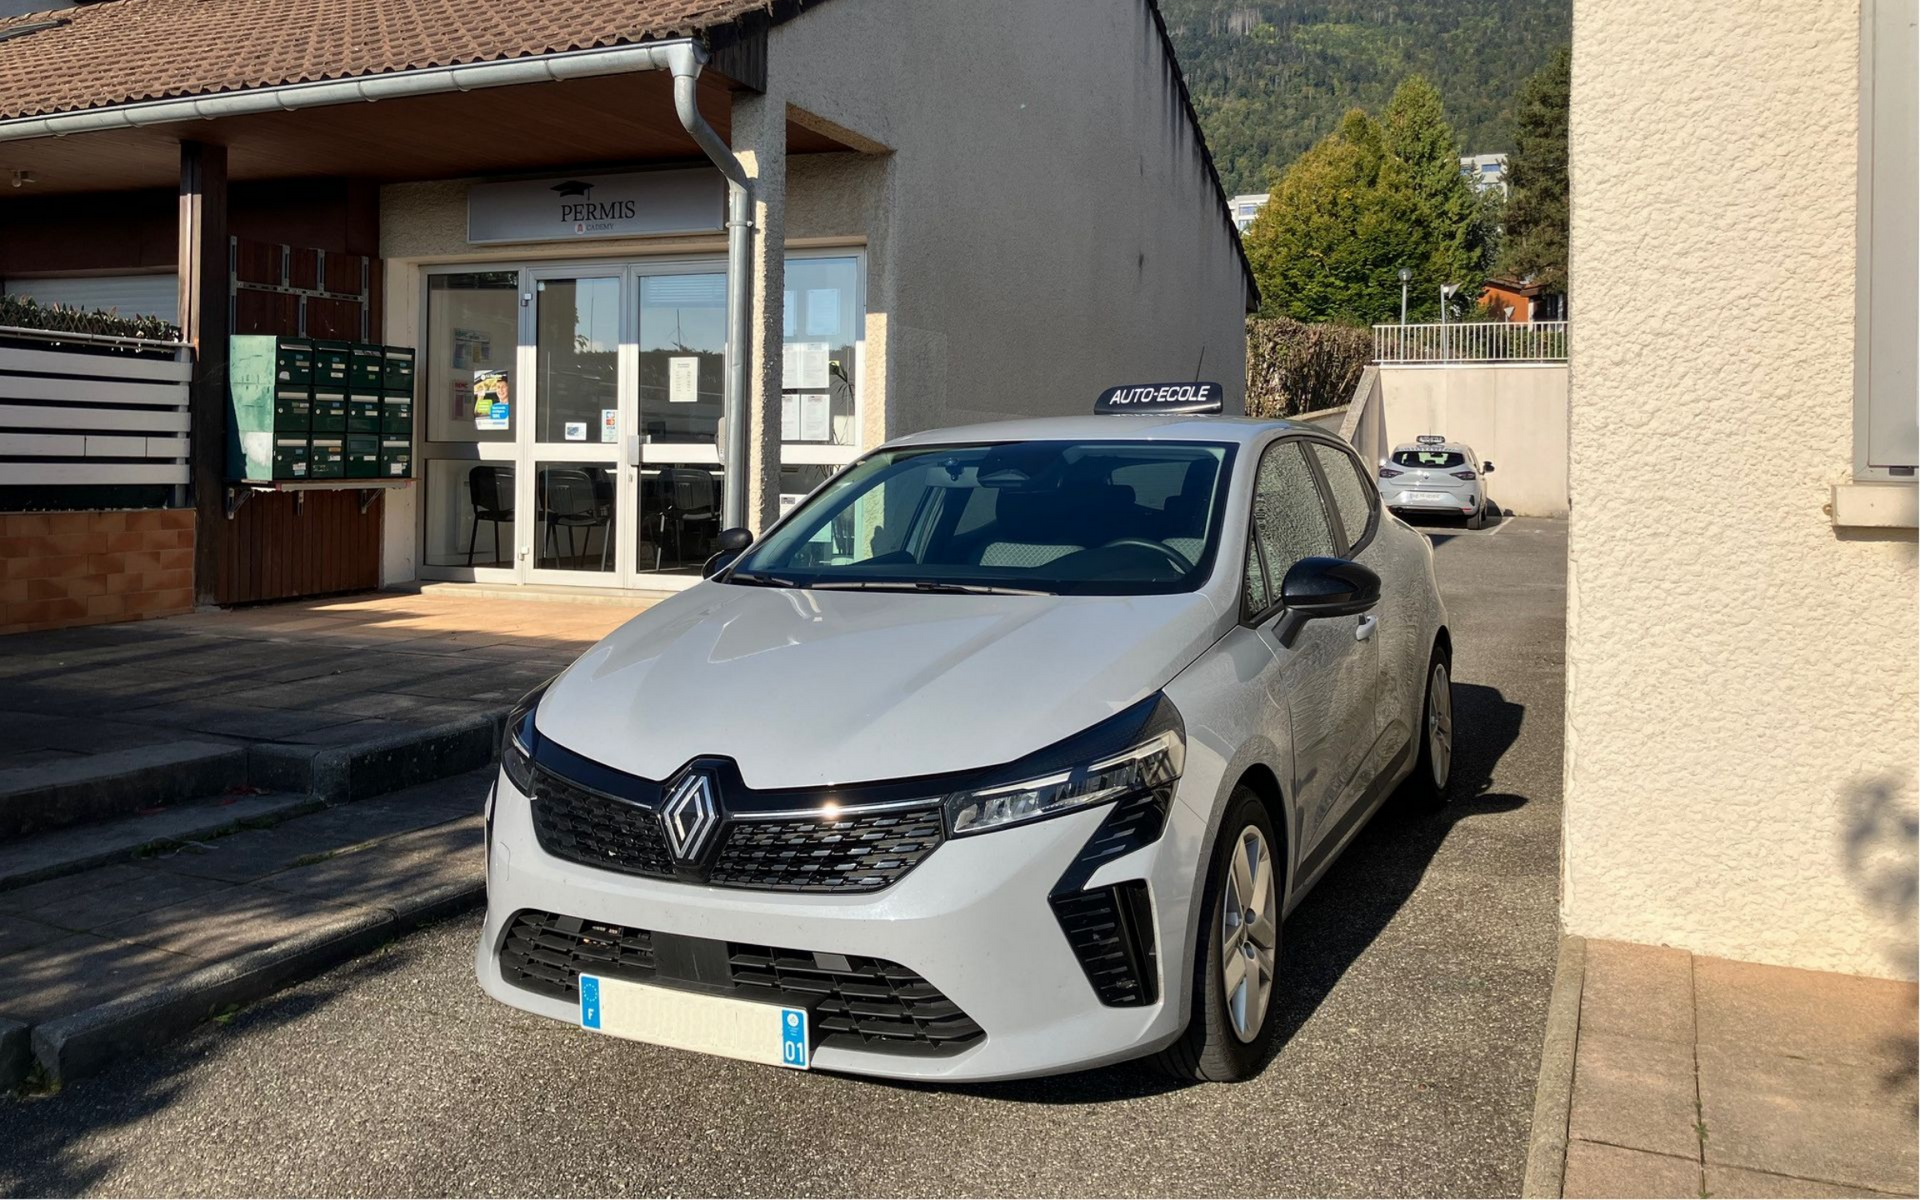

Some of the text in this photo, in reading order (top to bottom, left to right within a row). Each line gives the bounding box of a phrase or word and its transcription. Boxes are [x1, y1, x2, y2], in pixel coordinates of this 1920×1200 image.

[561, 200, 635, 222] PERMIS
[1109, 385, 1211, 405] AUTO-ECOLE
[588, 1008, 594, 1020] F
[785, 1040, 804, 1063] 01
